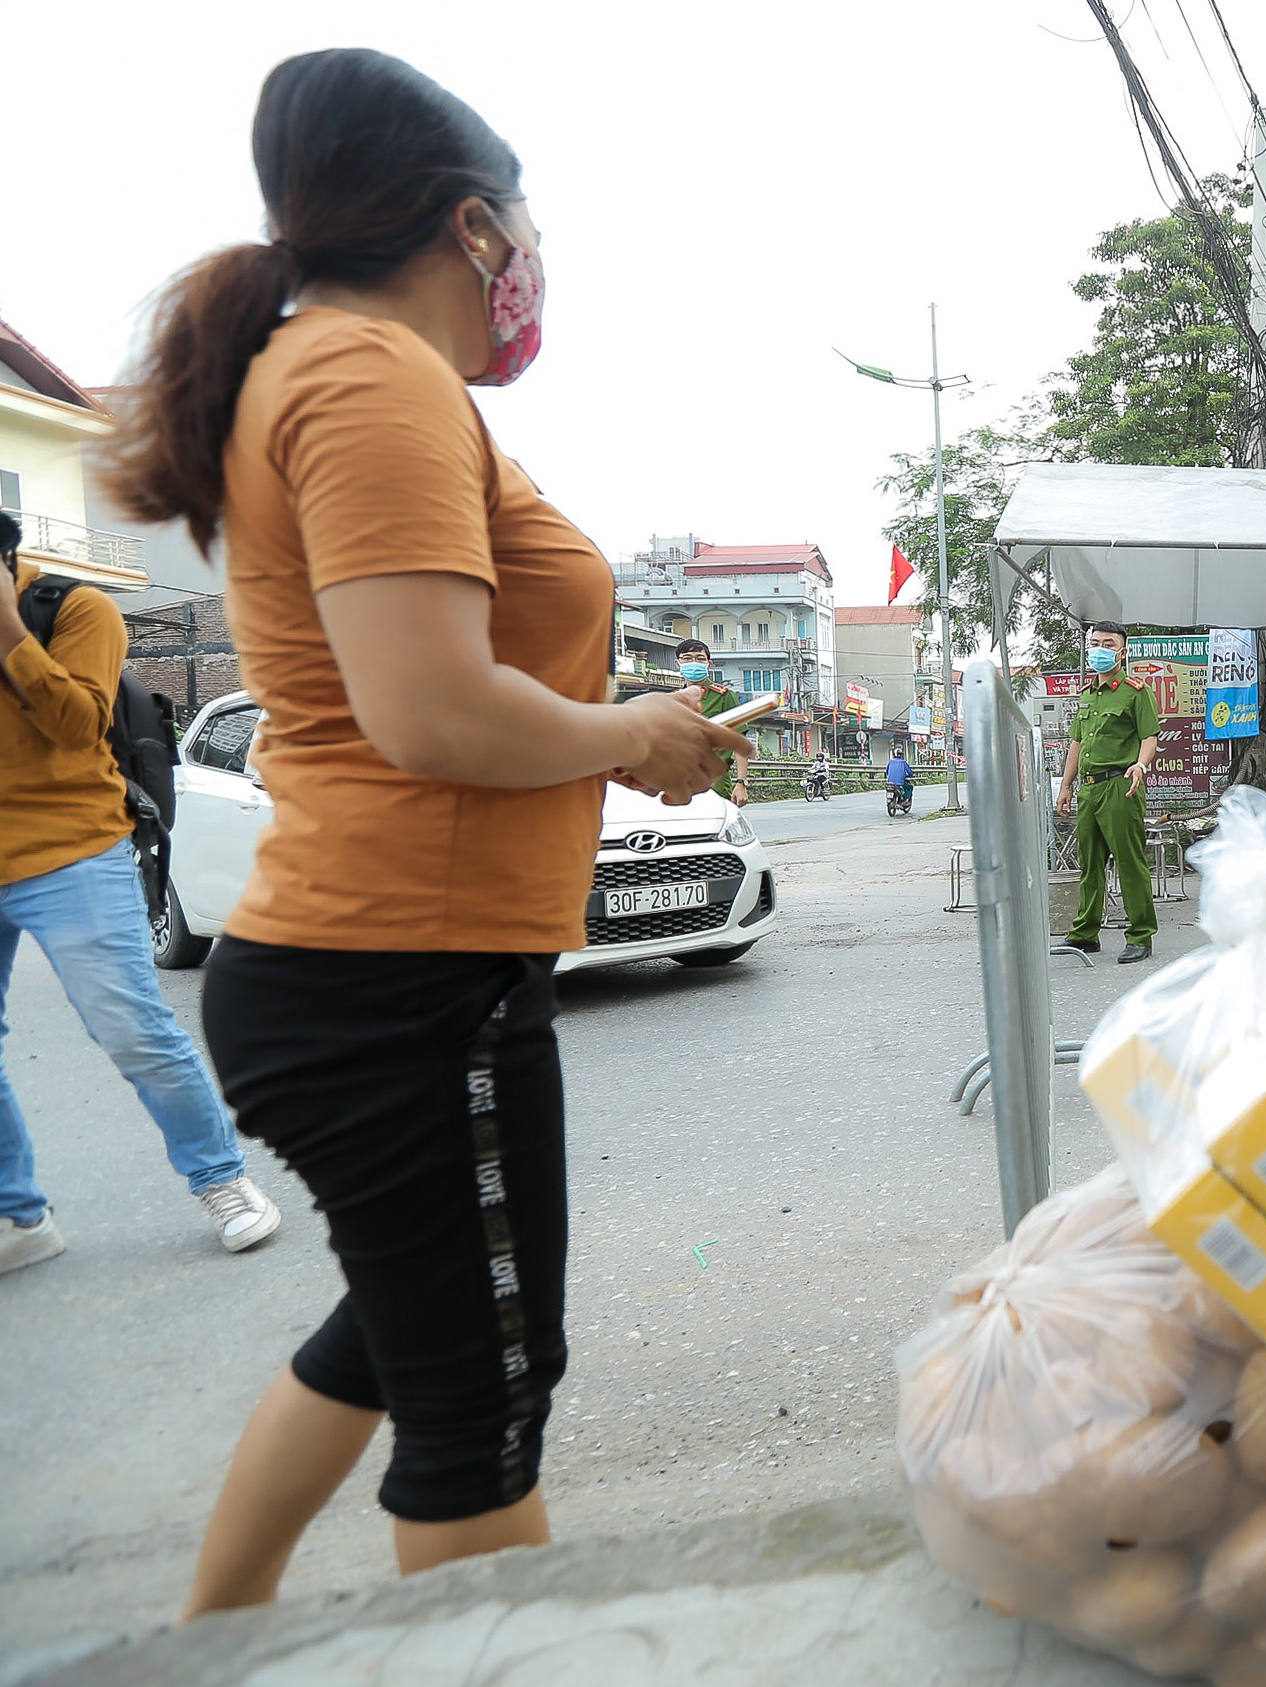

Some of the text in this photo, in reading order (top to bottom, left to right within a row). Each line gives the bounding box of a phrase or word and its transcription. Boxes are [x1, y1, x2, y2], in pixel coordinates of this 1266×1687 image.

[609, 884, 705, 914] 30F-281.70
[475, 1159, 507, 1208] LOVE
[489, 1252, 521, 1300] LOVE
